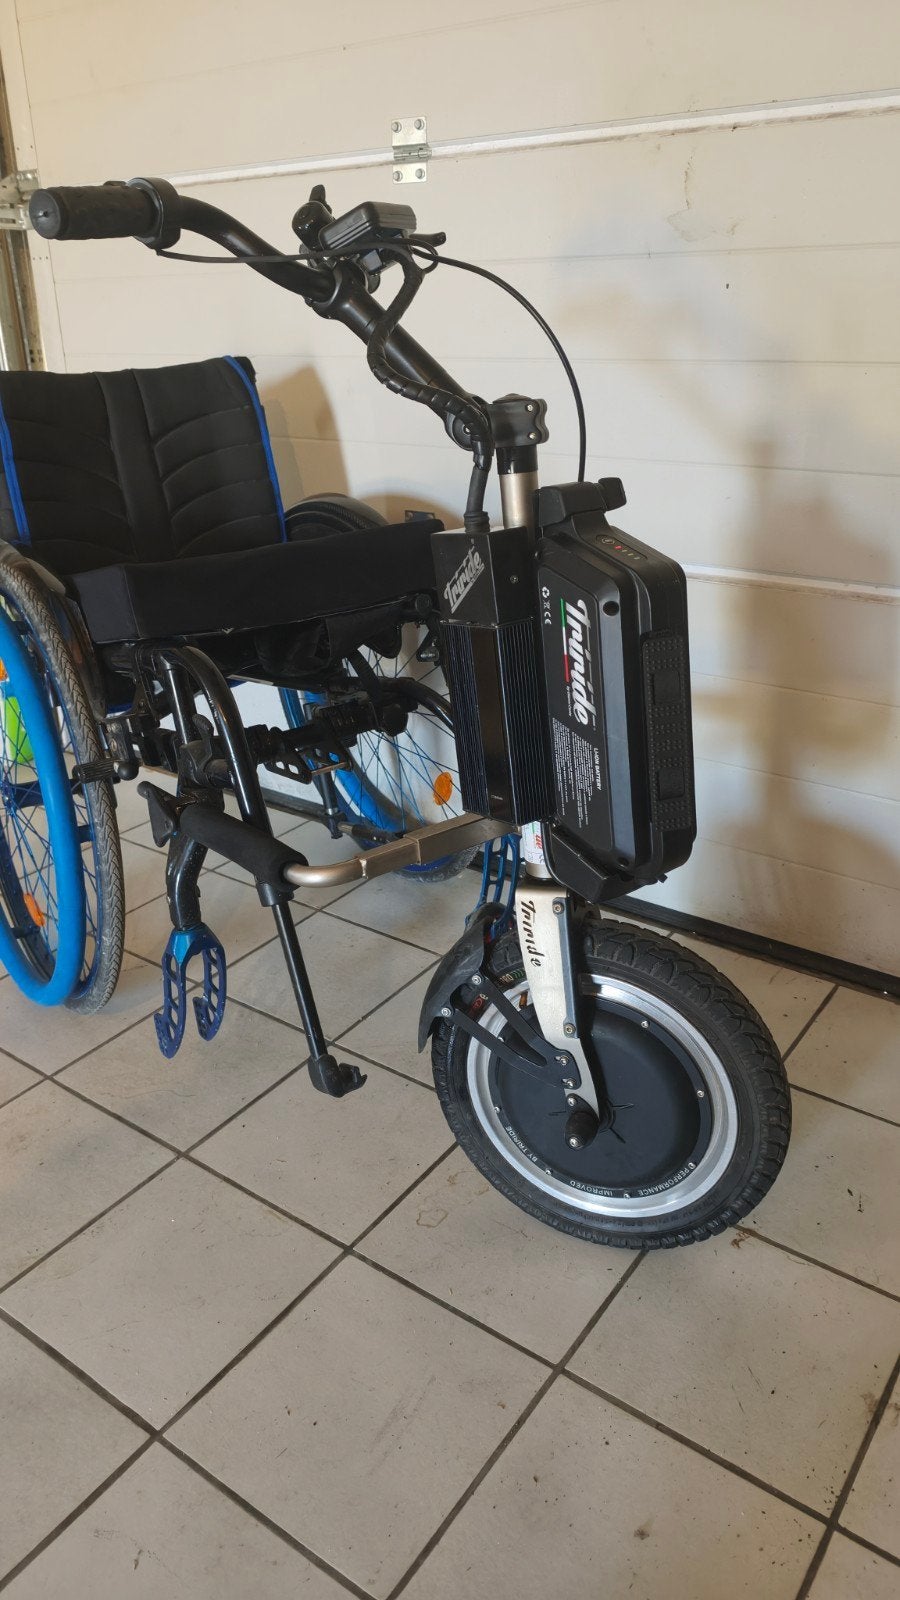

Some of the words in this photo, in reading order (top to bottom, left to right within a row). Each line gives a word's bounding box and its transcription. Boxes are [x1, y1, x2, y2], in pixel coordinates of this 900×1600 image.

[566, 599, 597, 725] Triride
[521, 900, 545, 967] Triride
[505, 1126, 527, 1154] TRIRIDE
[528, 1153, 537, 1163] BY
[570, 1180, 613, 1196] IMPROVED
[638, 1168, 689, 1196] PERFORMANCE
